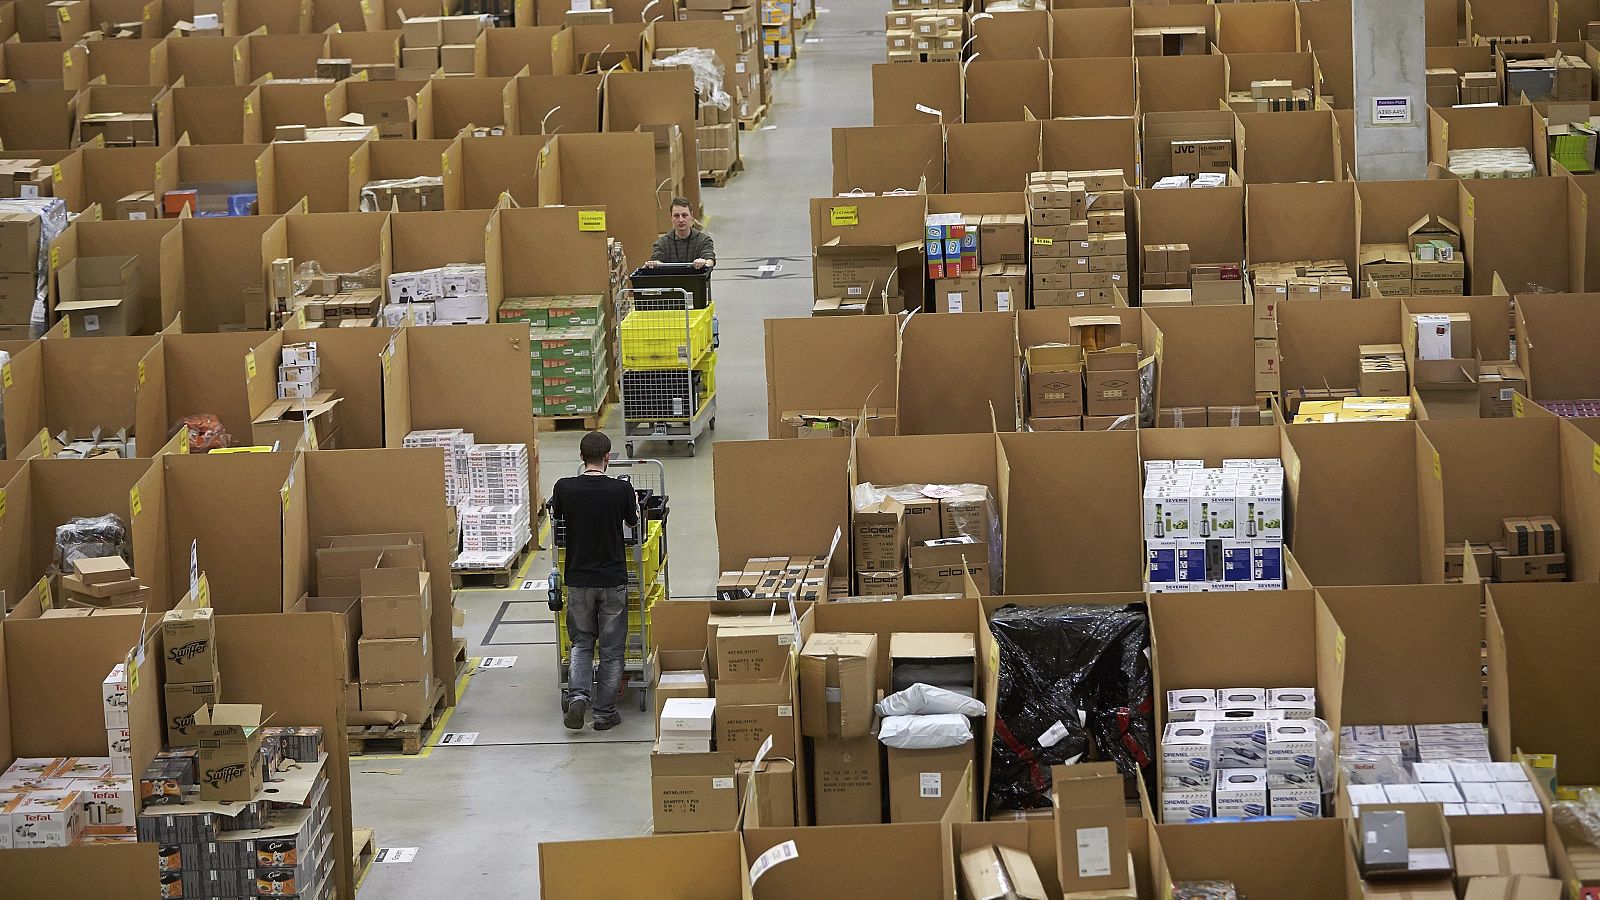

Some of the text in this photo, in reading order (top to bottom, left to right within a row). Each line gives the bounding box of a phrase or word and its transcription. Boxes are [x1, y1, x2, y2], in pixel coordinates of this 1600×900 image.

[1174, 145, 1195, 154] JVC
[905, 507, 931, 515] oer
[860, 526, 894, 534] cloer
[938, 567, 983, 577] cloer
[167, 641, 208, 662] Swiffer
[203, 764, 245, 785] Swiffer
[92, 791, 120, 799] Tefal
[24, 814, 52, 822] Tefal
